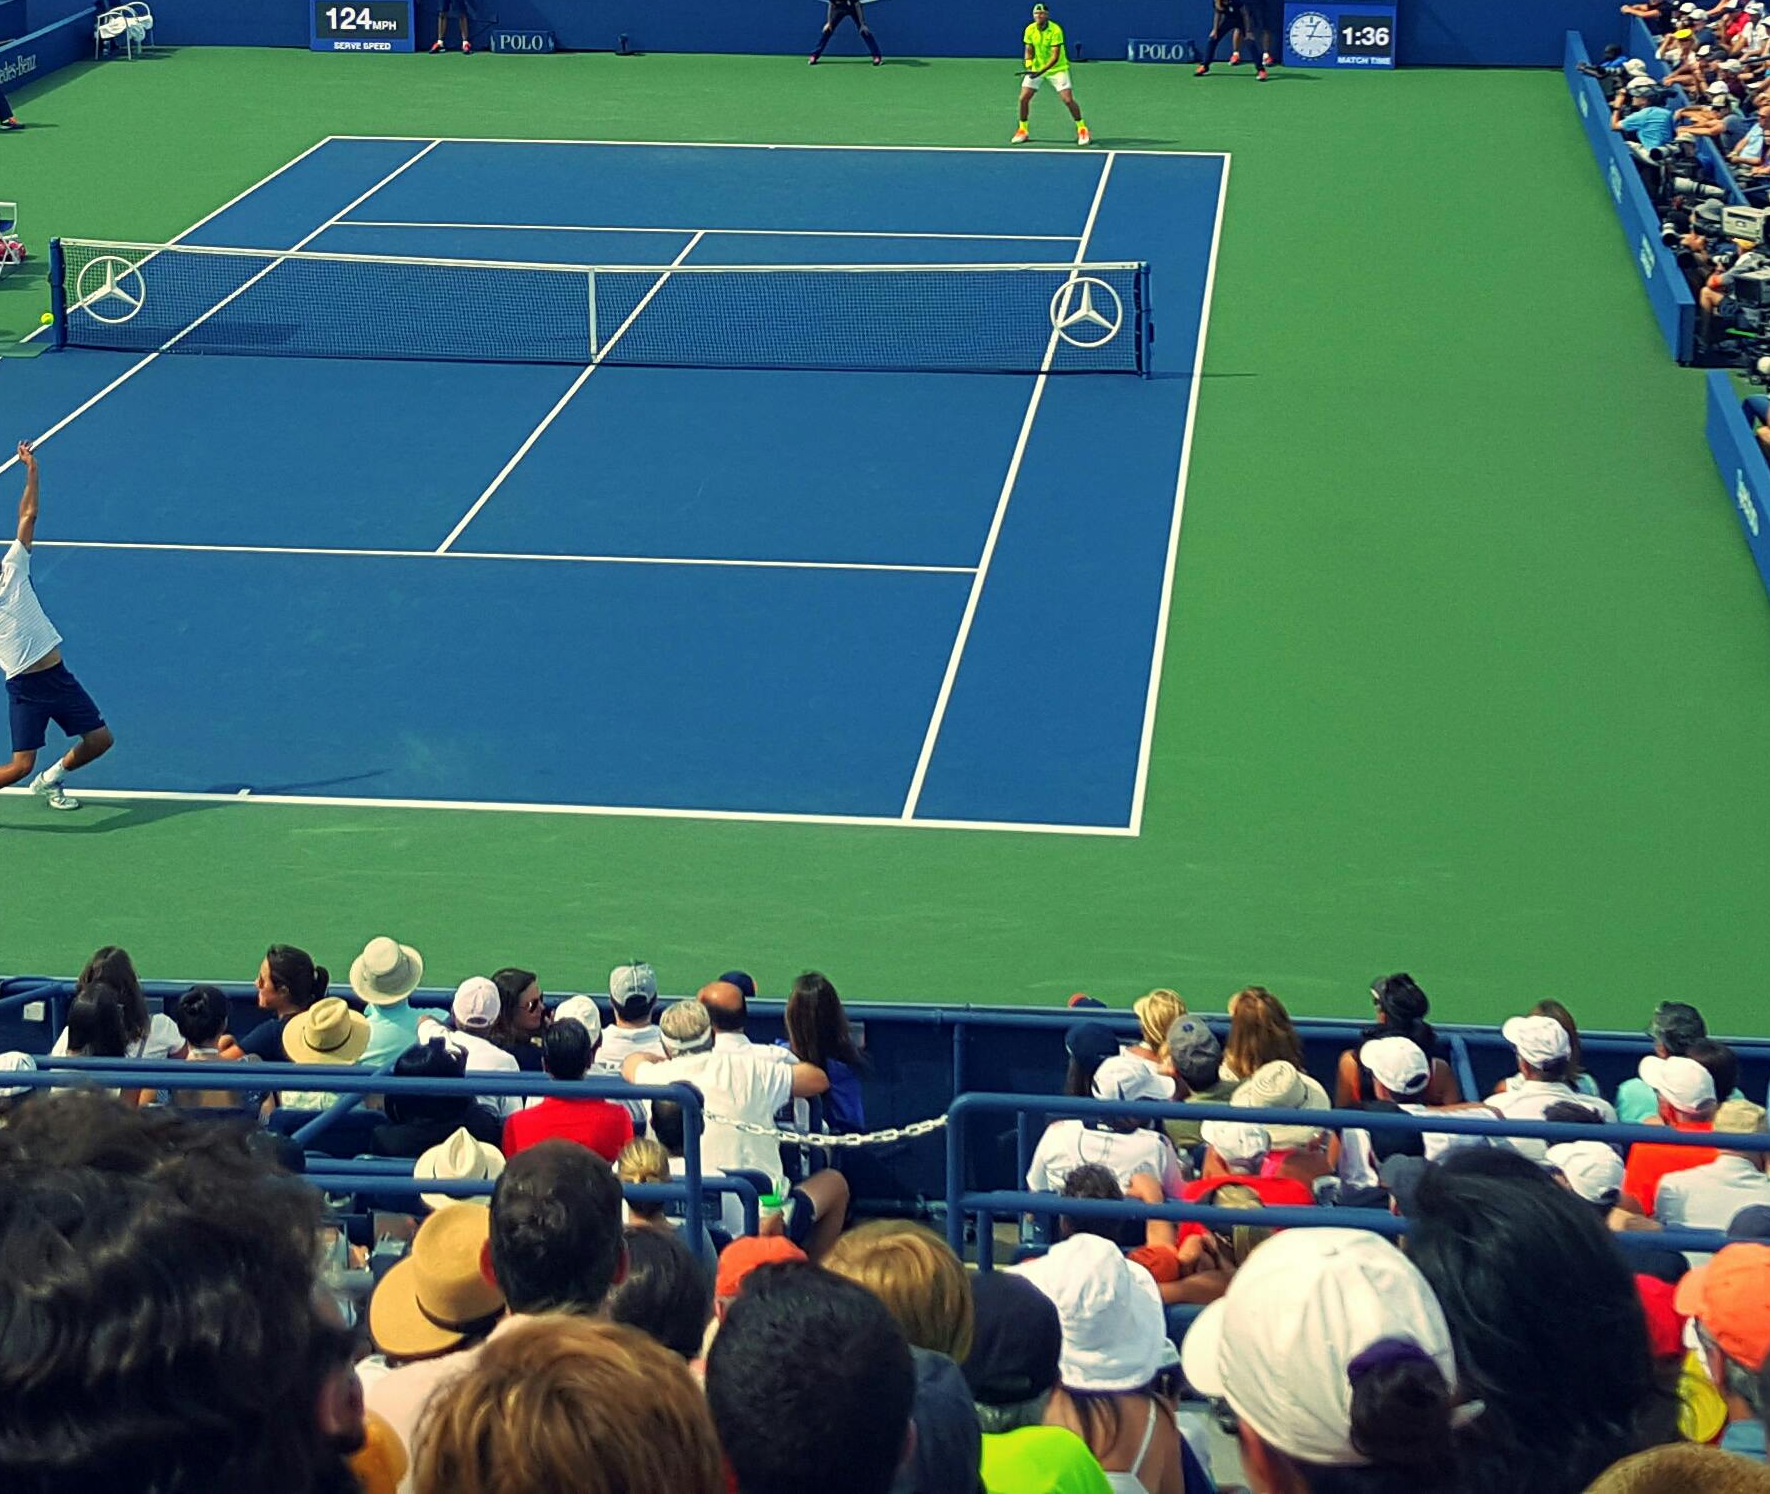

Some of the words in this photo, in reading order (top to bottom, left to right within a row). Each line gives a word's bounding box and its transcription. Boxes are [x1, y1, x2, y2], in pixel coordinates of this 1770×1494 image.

[325, 6, 372, 30] 124
[372, 20, 397, 31] MPH
[499, 34, 544, 51] POLO
[1342, 26, 1390, 46] 1:36
[333, 41, 362, 50] SERVE
[362, 42, 392, 50] SPEED
[1138, 43, 1184, 60] POLO
